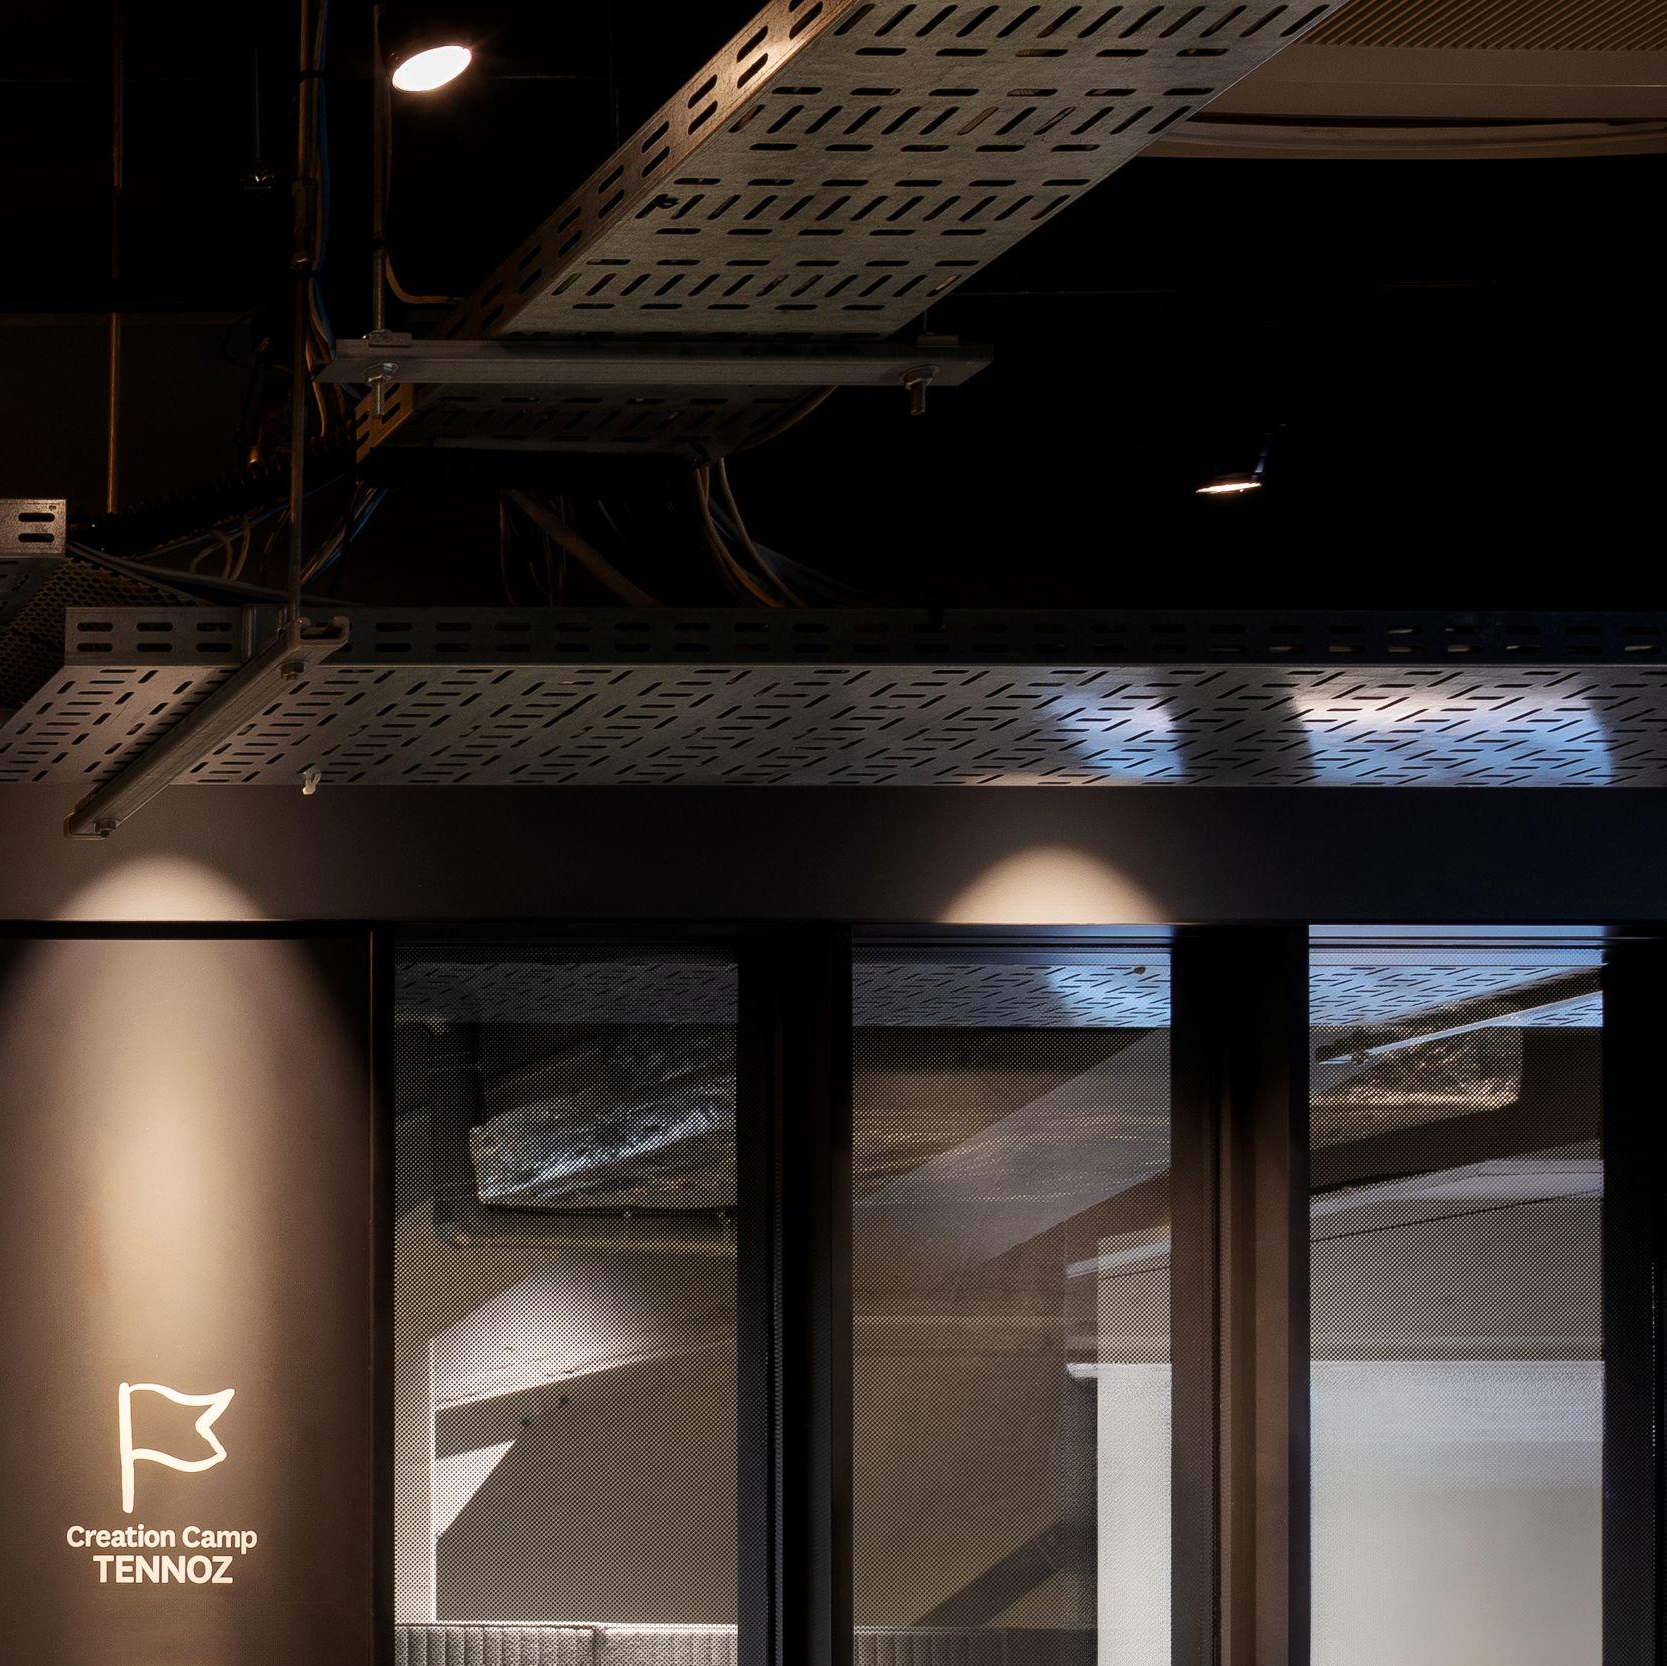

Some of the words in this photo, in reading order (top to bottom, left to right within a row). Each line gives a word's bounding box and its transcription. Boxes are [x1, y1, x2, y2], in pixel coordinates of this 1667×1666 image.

[66, 1524, 176, 1548] Creation
[182, 1526, 258, 1555] Camp
[93, 1555, 234, 1584] TENNOZ
